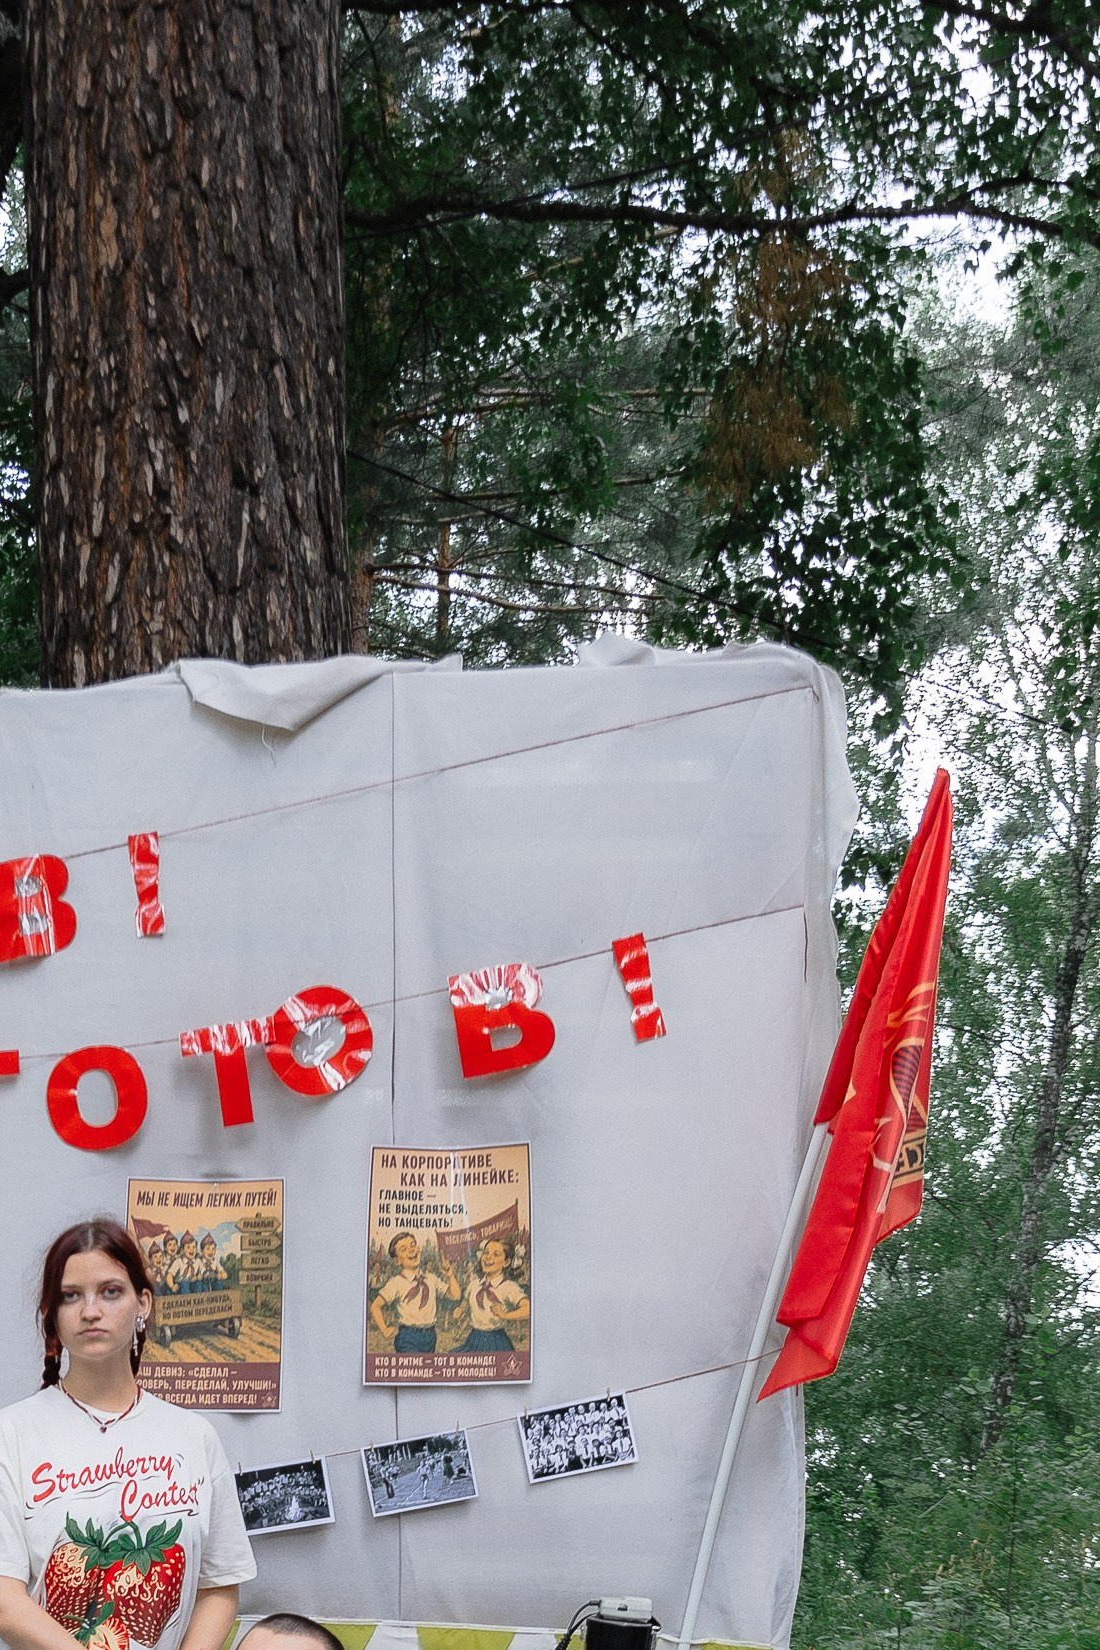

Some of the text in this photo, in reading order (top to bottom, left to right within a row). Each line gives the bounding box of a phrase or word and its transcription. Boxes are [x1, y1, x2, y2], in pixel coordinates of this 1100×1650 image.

[381, 1153, 492, 1170] НА КОРПОРАТИВЕ
[400, 1168, 520, 1187] КАК НА ЛИНЕЙКЕ:
[136, 1188, 278, 1209] МЫ НЕ ИЩЕМ ЛЕГКИХ ПУТЕЙ!
[379, 1189, 424, 1201] ГЛАВНОЕ
[378, 1203, 468, 1216] НЕ ВЫДЕЛЯТЬСЯ,
[378, 1216, 454, 1230] НО ТАНЦЕВАТЬ!
[162, 1298, 192, 1310] СДЕЛАЕМ
[162, 1304, 233, 1321] НО ПОТОМ ПЕРЕДЕЛАЕМ
[375, 1356, 389, 1366] КТО
[391, 1356, 397, 1366] В
[398, 1356, 424, 1367] РИТМЕ
[433, 1356, 447, 1366] ТОТ
[449, 1356, 455, 1366] В
[456, 1355, 496, 1367] КОМАНДЕ!
[137, 1366, 152, 1377] АШ
[154, 1366, 186, 1378] ДЕВИЗ:
[188, 1367, 229, 1379] «СДЕЛАЛ
[375, 1368, 389, 1378] КТО
[391, 1368, 397, 1377] В
[398, 1368, 434, 1378] КОМАНДЕ
[441, 1368, 456, 1377] ТОТ
[457, 1367, 497, 1378] МОЛОДЕЦ!
[136, 1378, 277, 1392] РОВЕРЬ, ПЕРЕДЕЛАЙ, УЛУЧШИ!»
[165, 1393, 197, 1405] ВСЕГДА
[199, 1393, 220, 1405] ИДЕТ
[222, 1394, 257, 1406] ВПЕРЕД!
[31, 1446, 174, 1503] Strawberry
